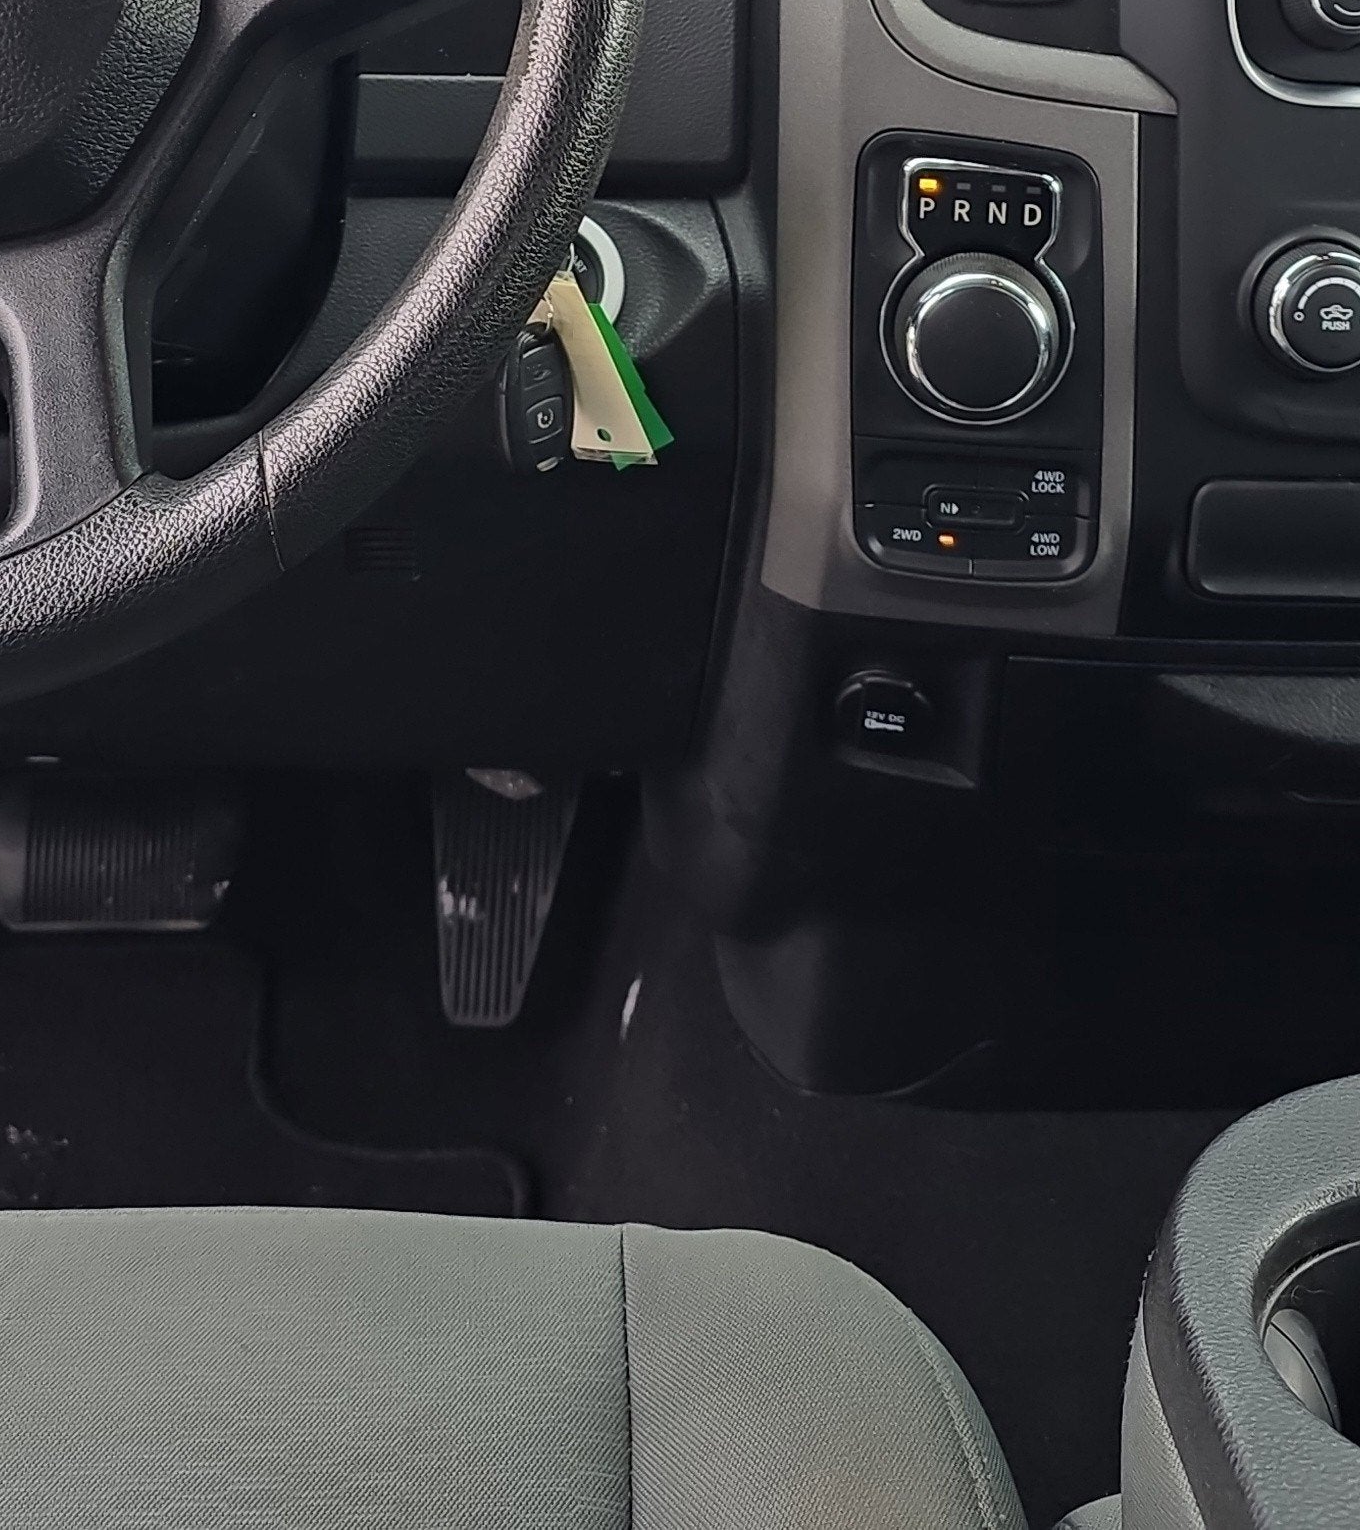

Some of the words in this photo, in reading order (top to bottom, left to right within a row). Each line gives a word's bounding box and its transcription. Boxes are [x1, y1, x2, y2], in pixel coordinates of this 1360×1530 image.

[919, 197, 936, 219] P
[954, 198, 971, 222] R
[988, 201, 1008, 225] N
[1023, 203, 1043, 227] D
[1321, 320, 1351, 331] PUSH
[1034, 469, 1065, 483] 4WD
[1031, 480, 1065, 494] LOCK
[940, 502, 952, 514] N
[892, 528, 922, 542] 2WD
[1031, 531, 1060, 545] 4WD
[1030, 543, 1060, 557] LOW
